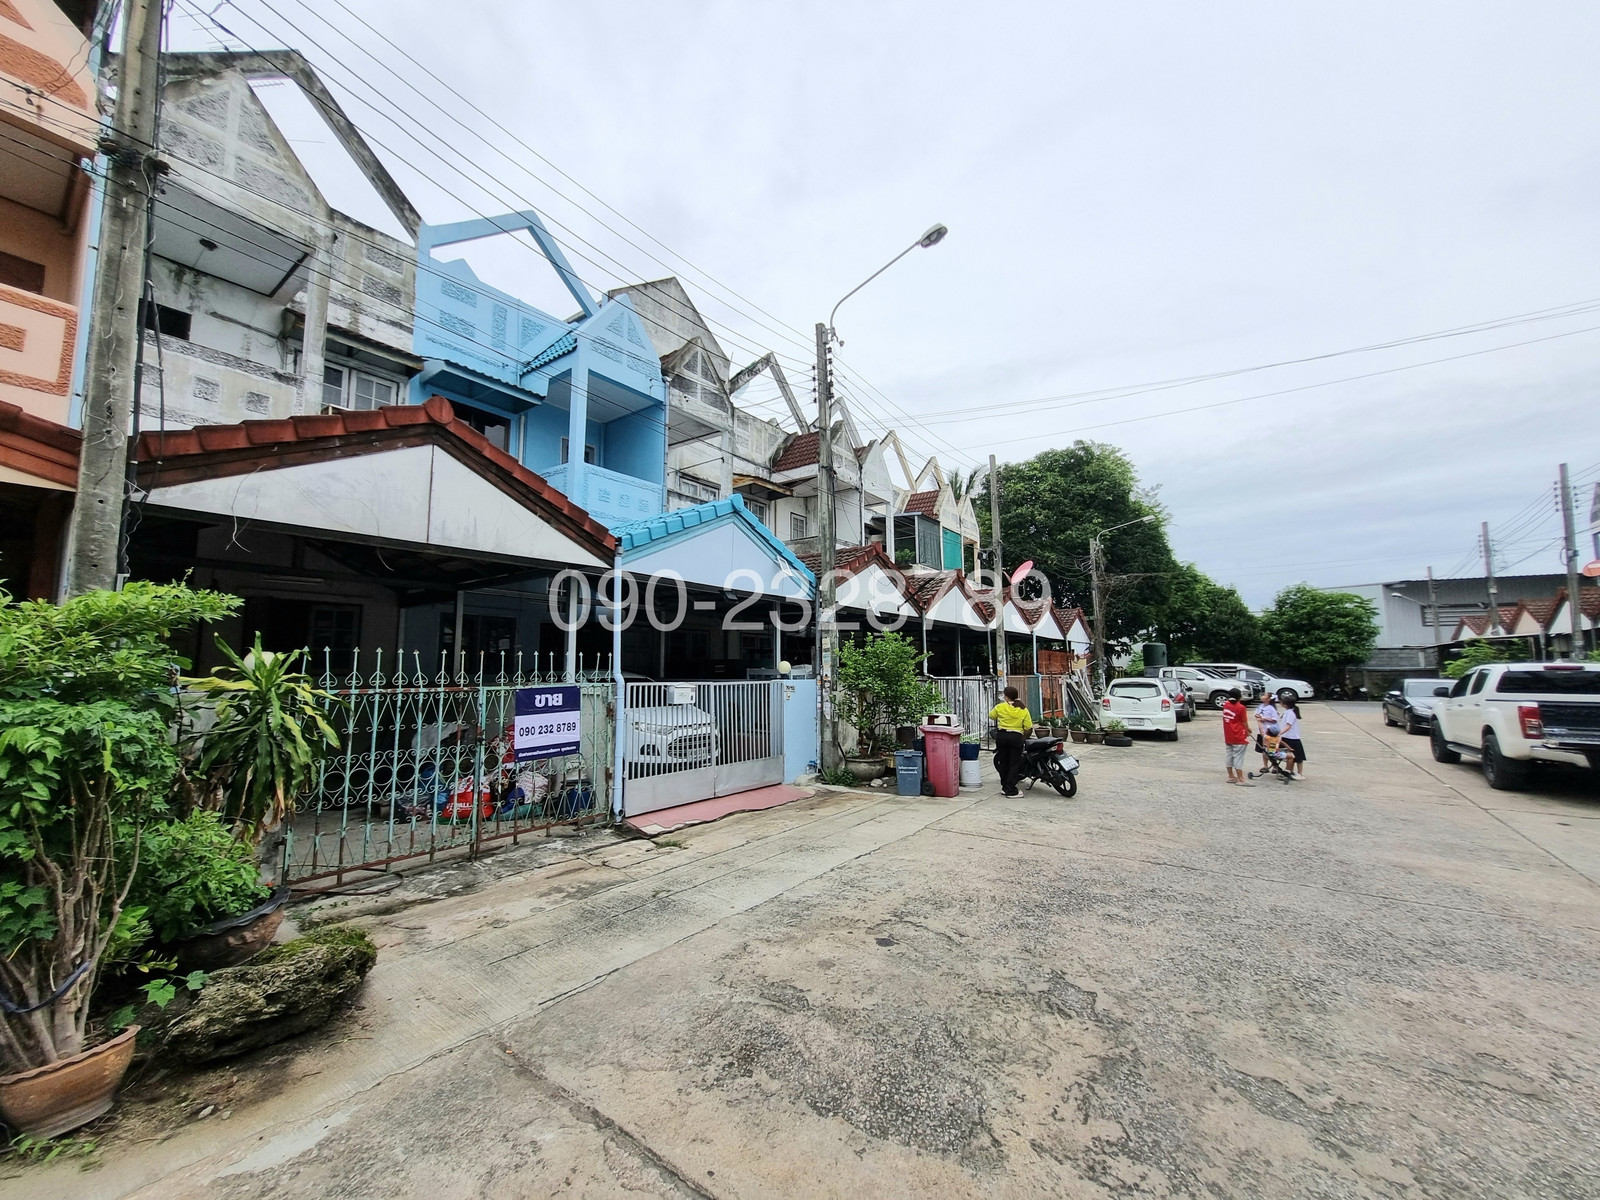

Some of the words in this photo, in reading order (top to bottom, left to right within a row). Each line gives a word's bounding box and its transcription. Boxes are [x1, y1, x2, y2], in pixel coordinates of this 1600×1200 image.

[534, 693, 563, 707] ขาย
[519, 726, 536, 737] 090
[538, 724, 554, 735] 232
[556, 722, 577, 733] 8789
